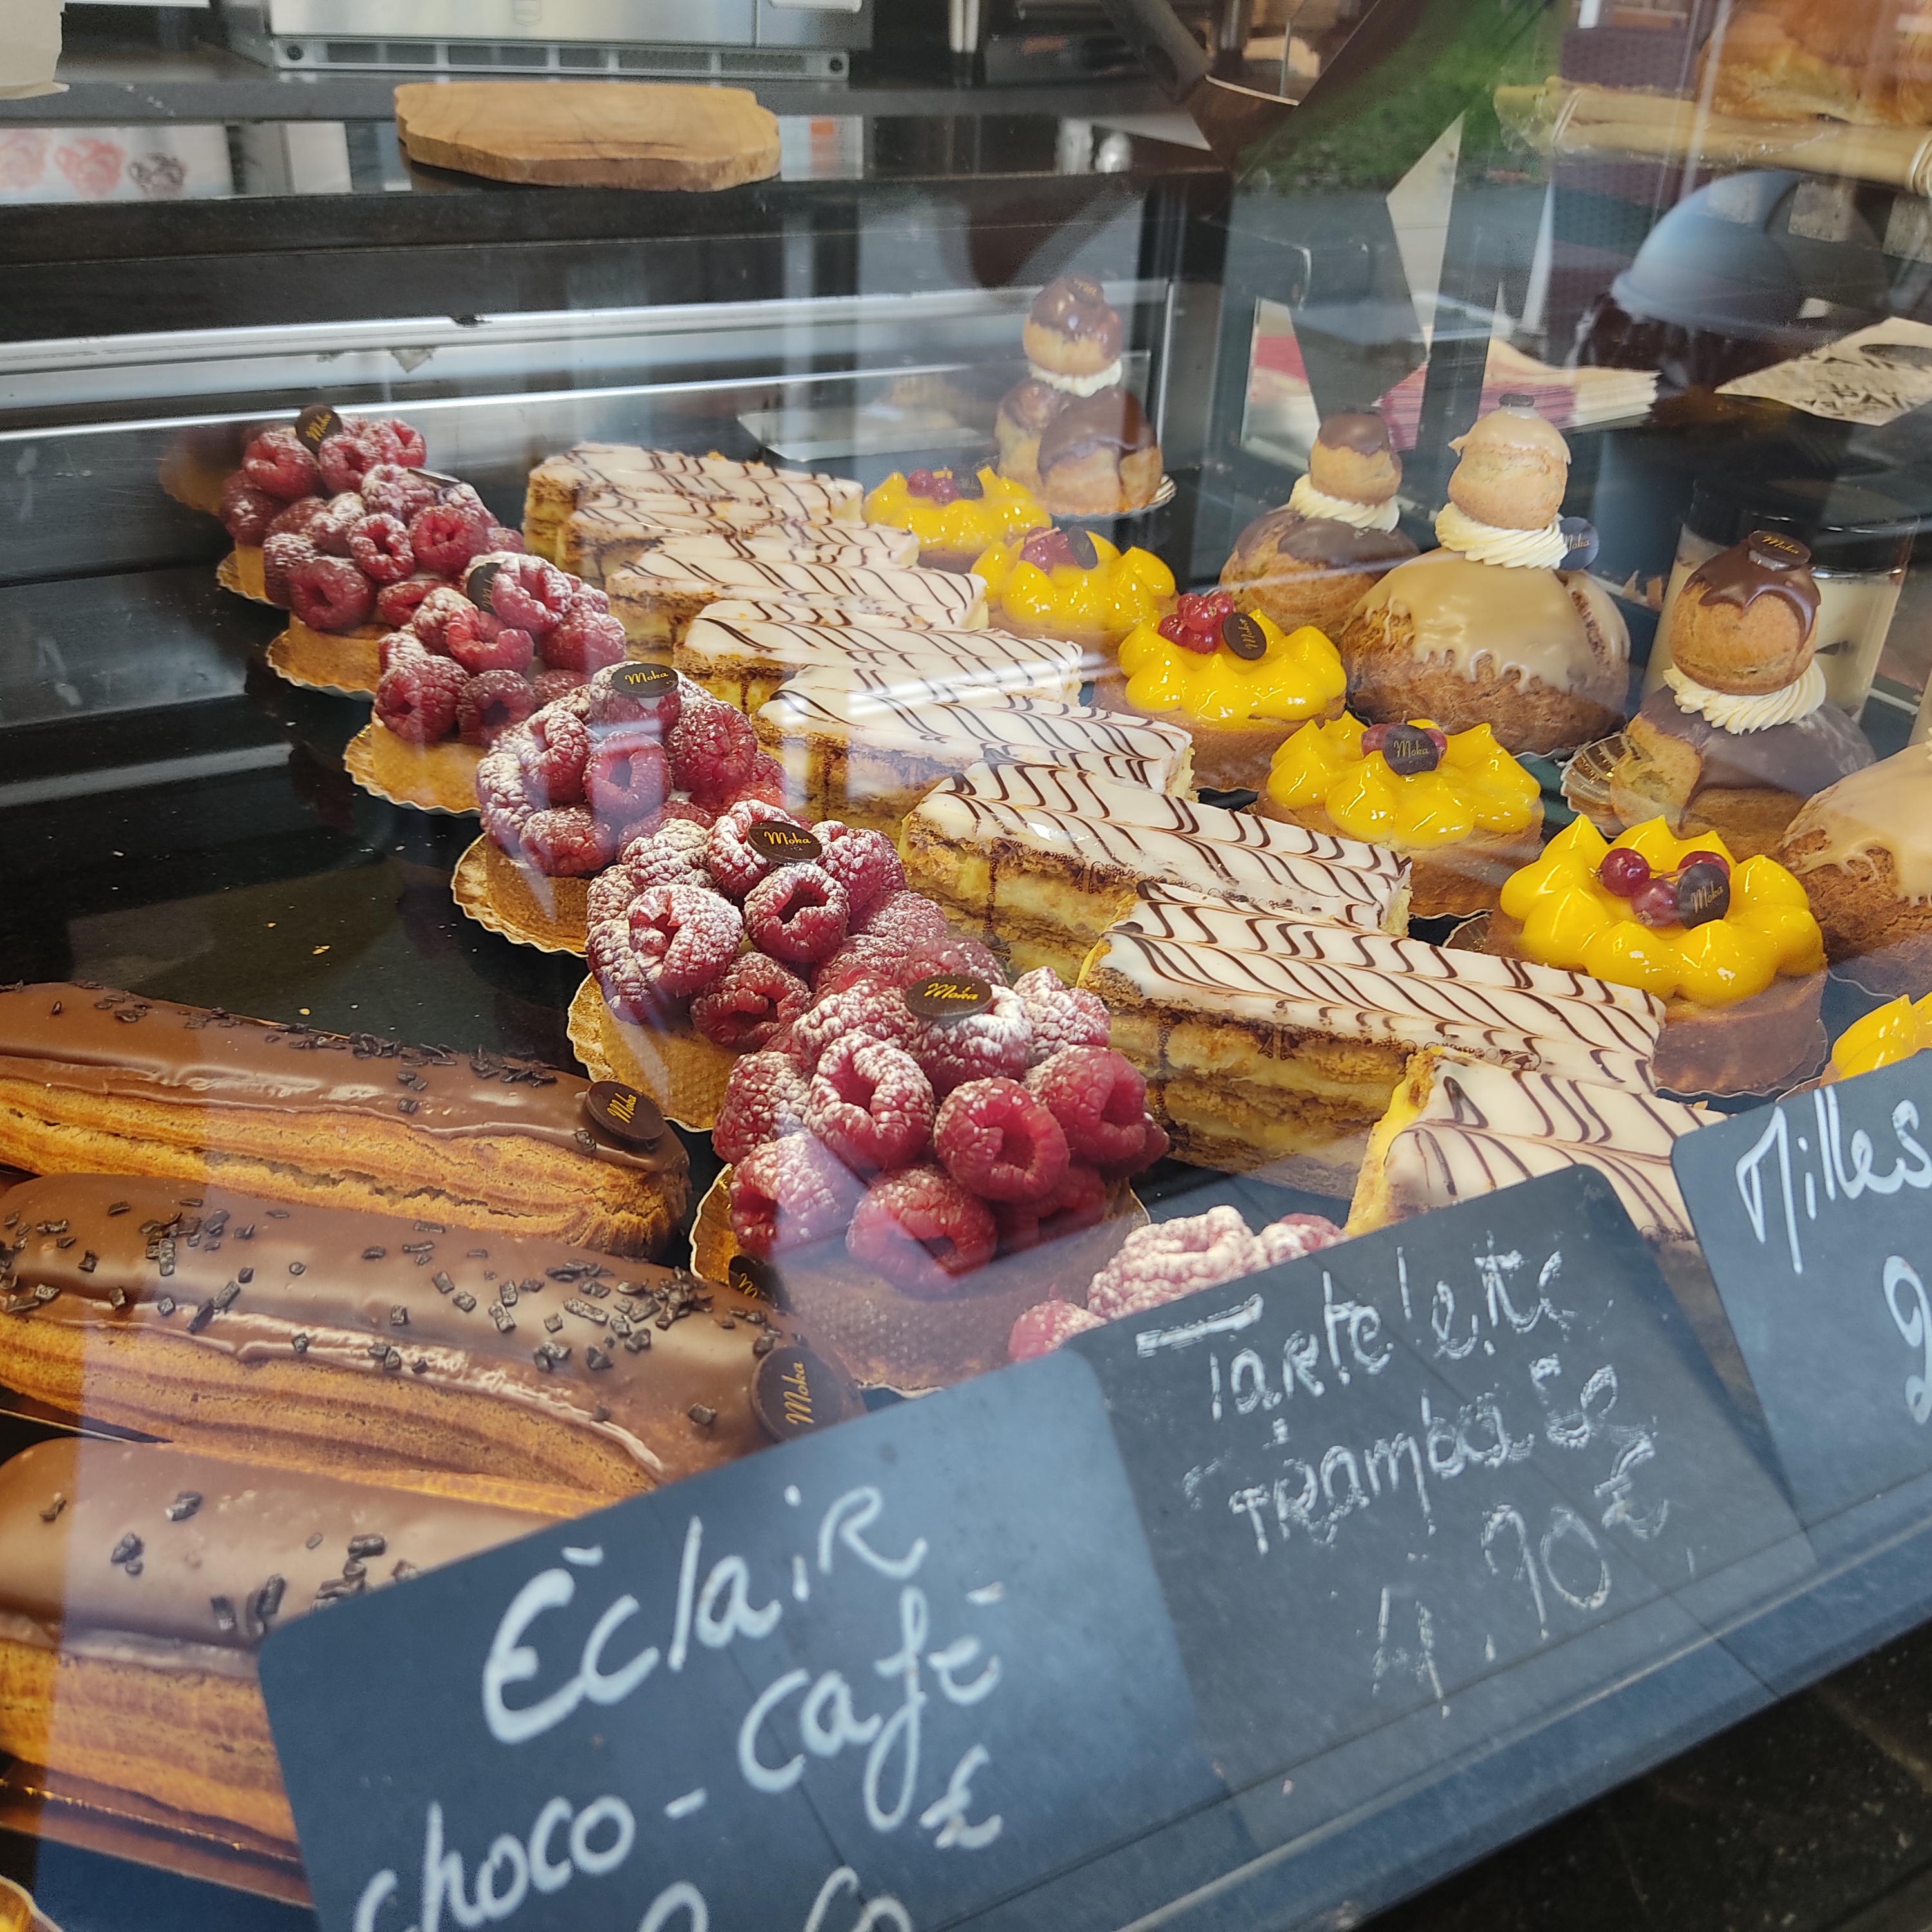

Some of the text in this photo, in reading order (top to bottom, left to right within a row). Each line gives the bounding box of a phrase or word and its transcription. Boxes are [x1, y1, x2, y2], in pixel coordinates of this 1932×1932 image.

[625, 670, 669, 685] Moka
[1393, 740, 1430, 758] Moka
[764, 831, 811, 846] Moka
[1690, 880, 1725, 914] Moka
[923, 982, 979, 1001] Moka
[607, 1092, 637, 1124] Moka
[781, 1360, 815, 1425] Moka
